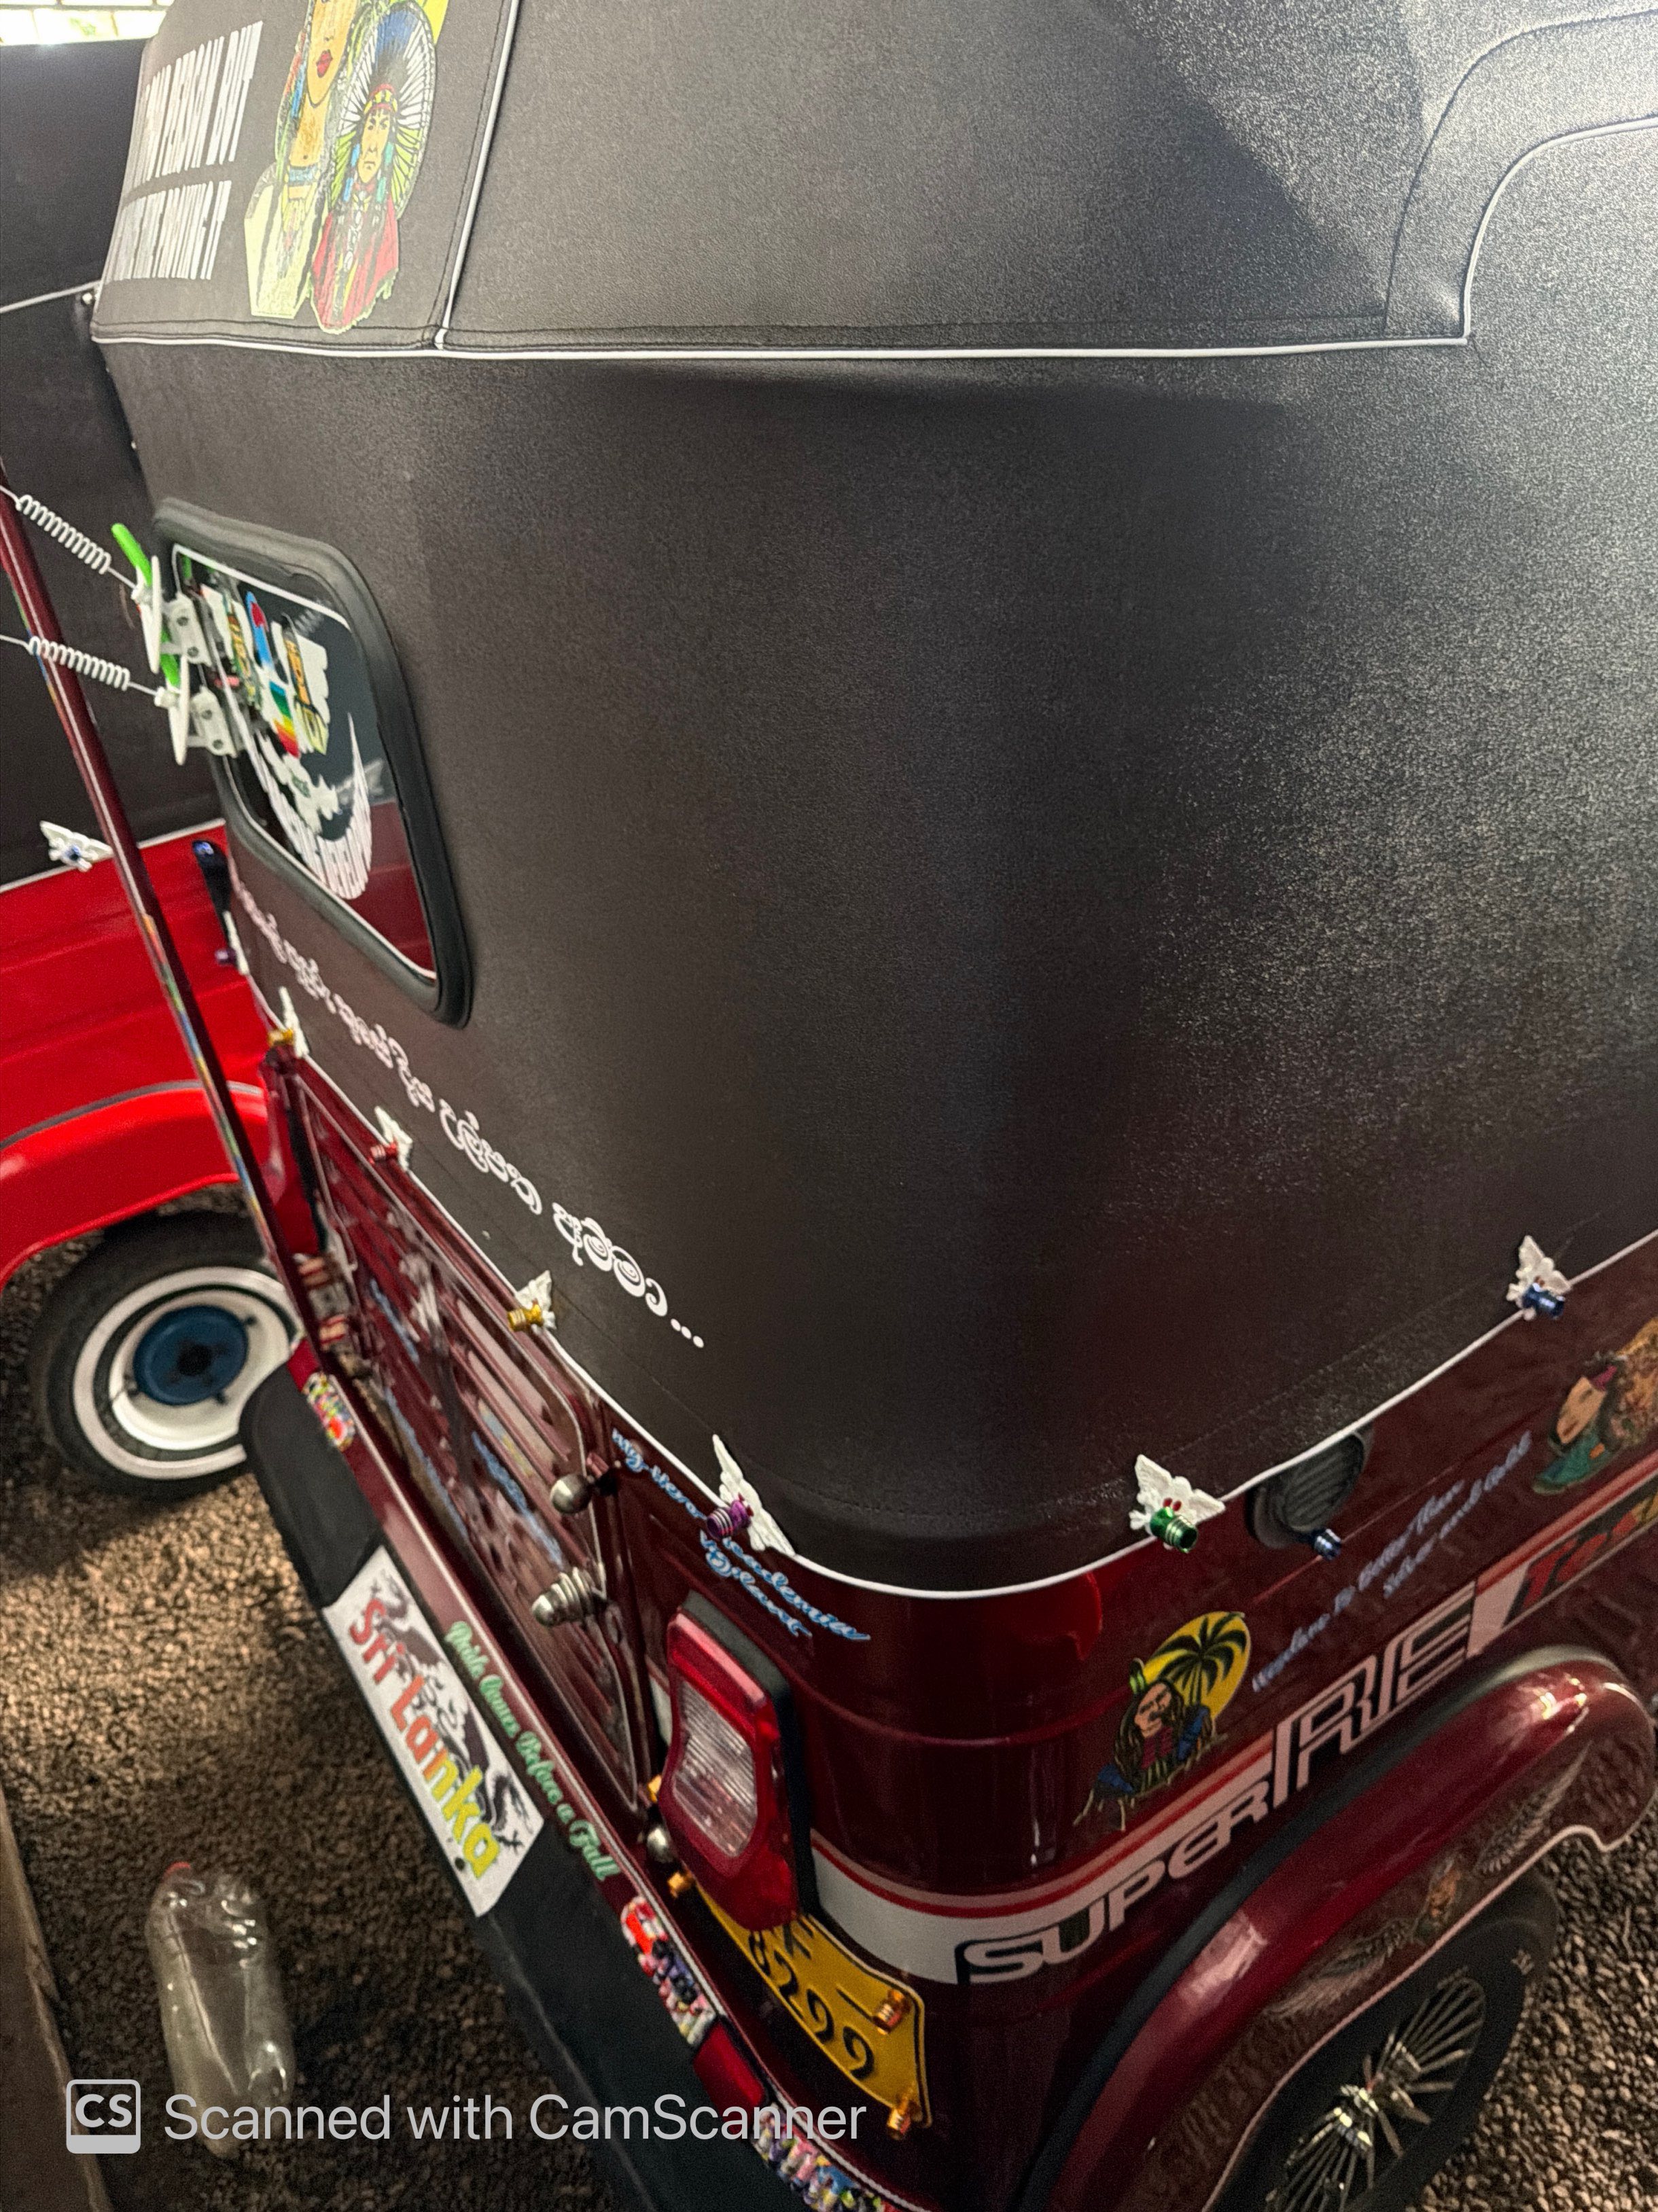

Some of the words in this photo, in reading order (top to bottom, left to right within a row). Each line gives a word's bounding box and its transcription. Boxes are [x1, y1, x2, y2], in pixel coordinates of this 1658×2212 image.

[155, 35, 225, 178] PERSON
[206, 20, 264, 166] BUT
[200, 180, 232, 280] IT
[348, 1597, 406, 1685] Sri
[389, 1675, 501, 1879] Lanka
[960, 1776, 1271, 1985] SUPER
